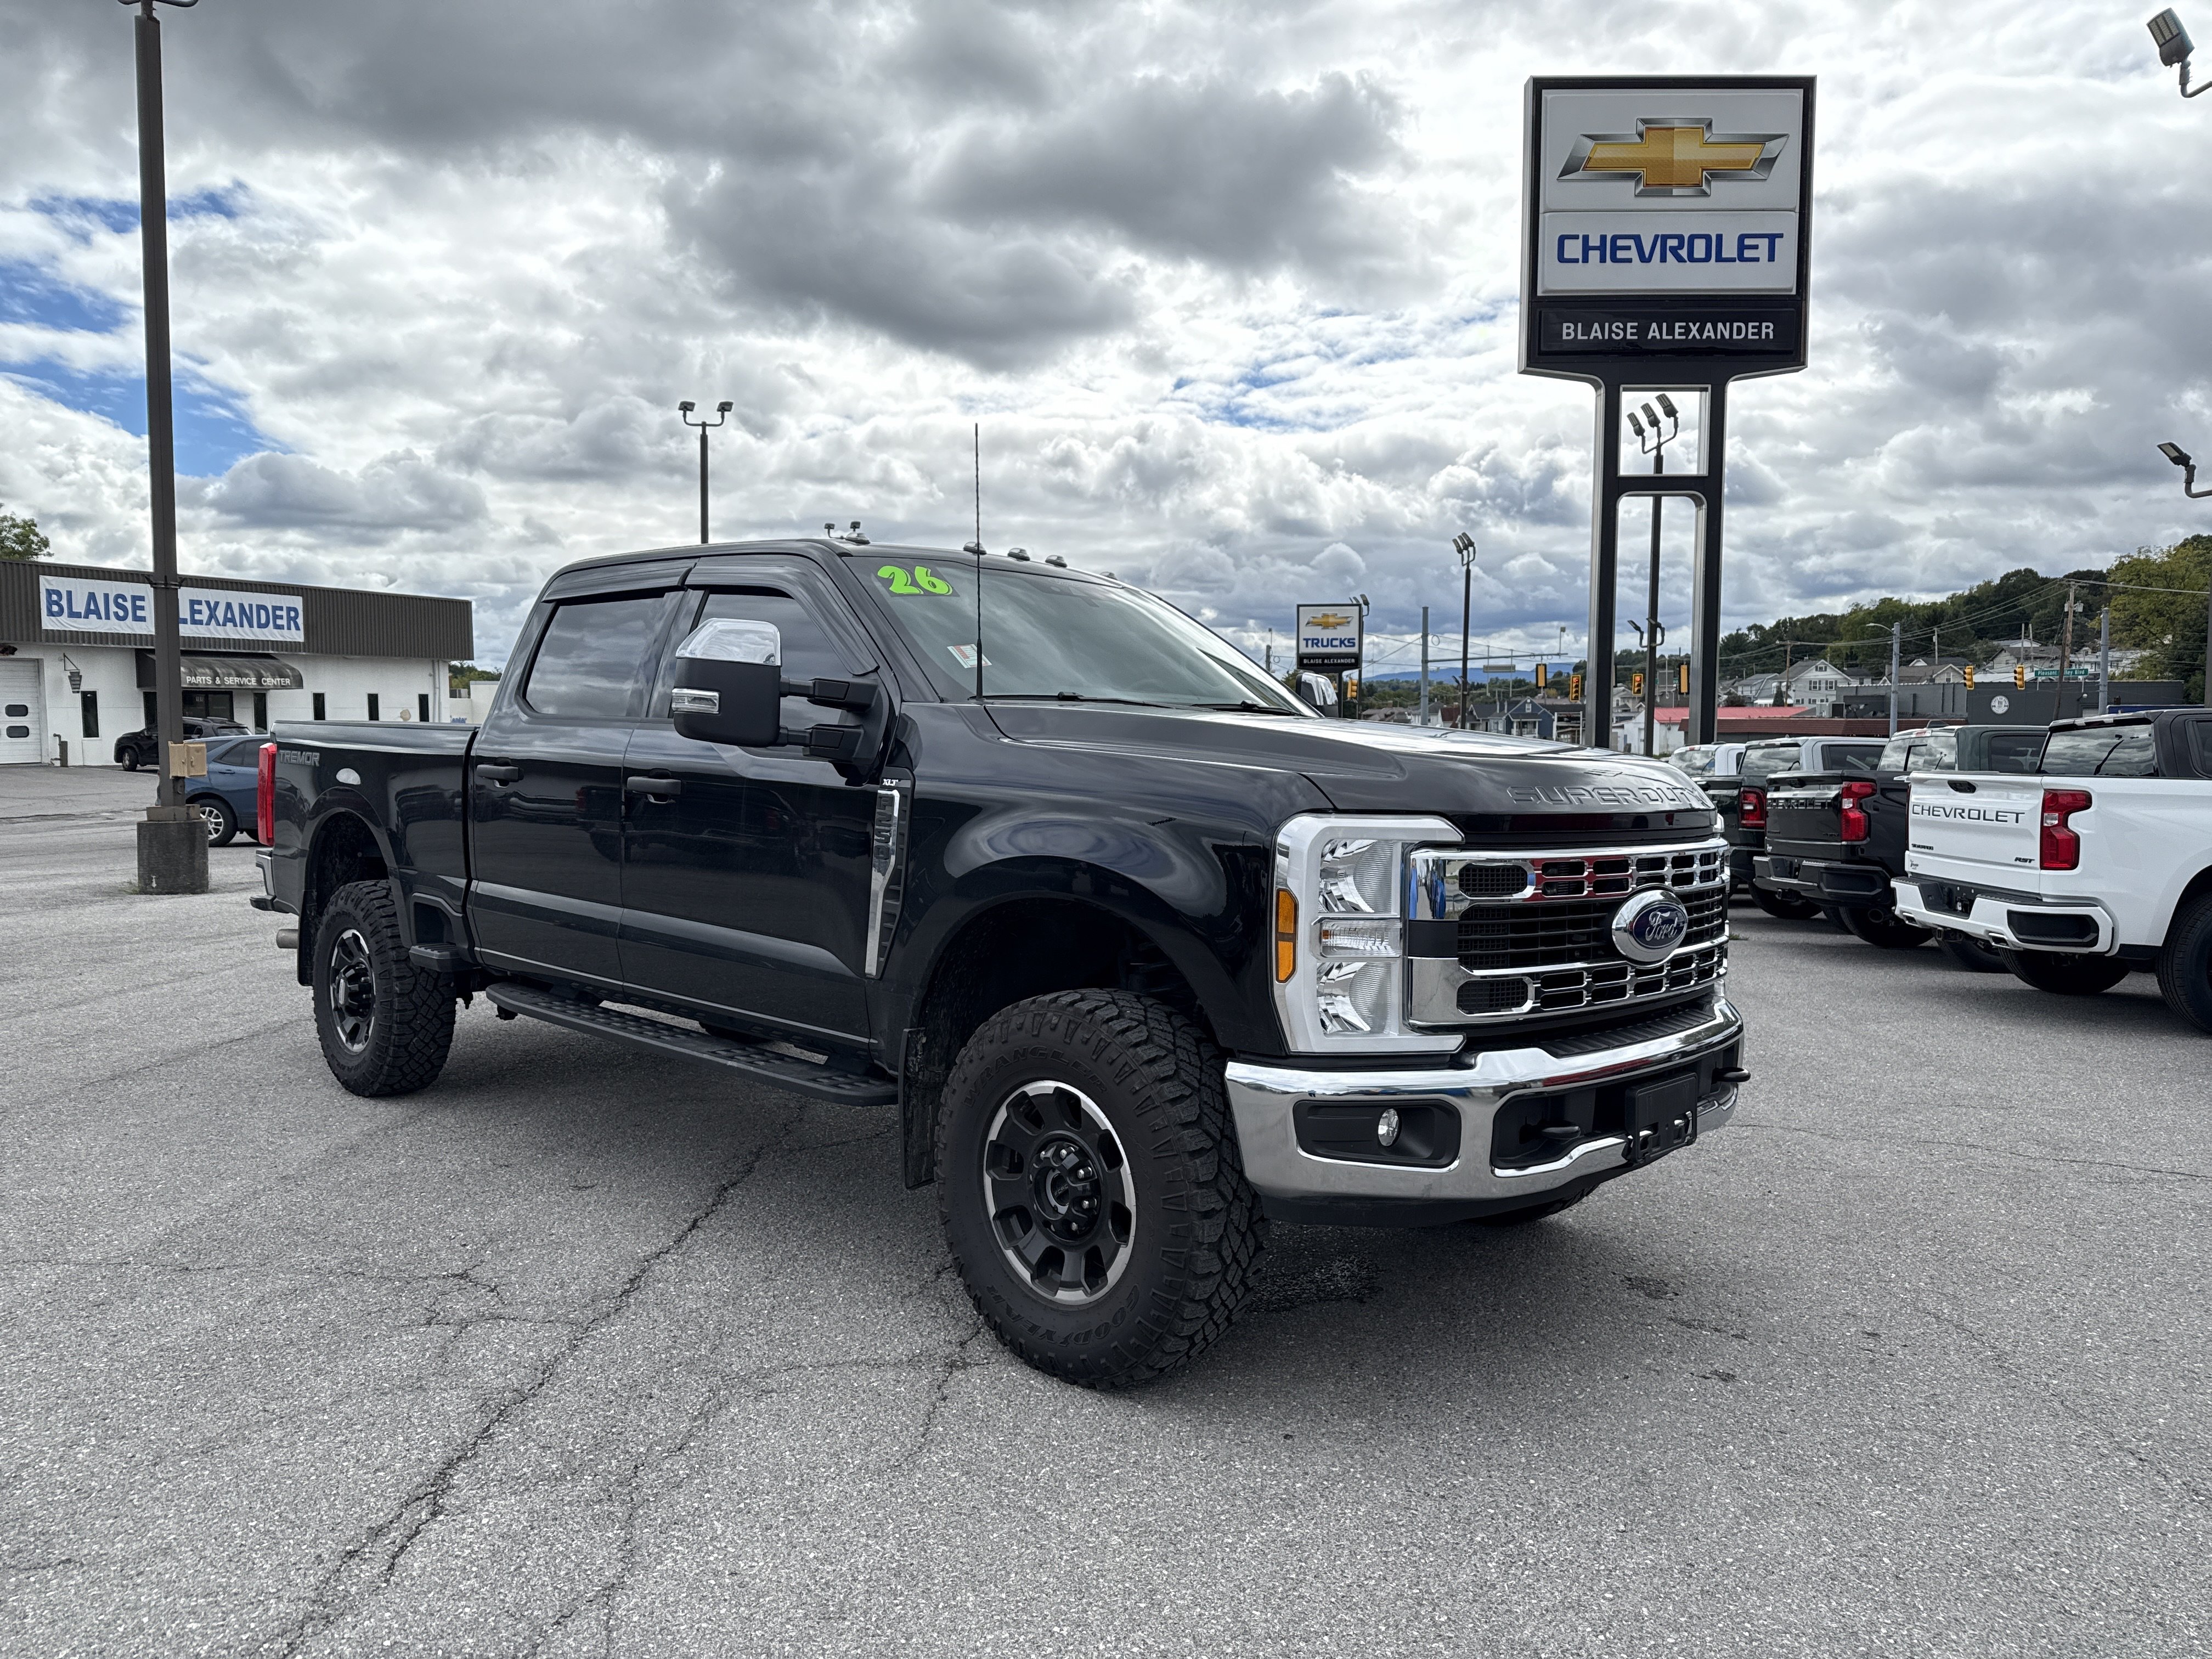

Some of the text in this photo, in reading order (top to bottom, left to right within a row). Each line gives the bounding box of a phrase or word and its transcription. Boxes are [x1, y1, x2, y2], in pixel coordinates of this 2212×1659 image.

[1557, 233, 1784, 263] CHEVROLET
[1562, 321, 1774, 340] BLAISE ALEXANDER
[878, 565, 953, 595] 26
[45, 588, 301, 631] BLAISE EXANDER
[1303, 637, 1356, 648] TRUCKS
[186, 676, 212, 685] PARTS
[279, 750, 320, 766] TREMOR
[1506, 786, 1710, 808] SUPER DUTY
[1767, 799, 1832, 810] CHEVROLET
[1912, 804, 2025, 823] CHEVROLET
[1645, 911, 1678, 941] Ford
[963, 1046, 1108, 1107] WRANGLER
[986, 1284, 1140, 1347] GOODYEAR
